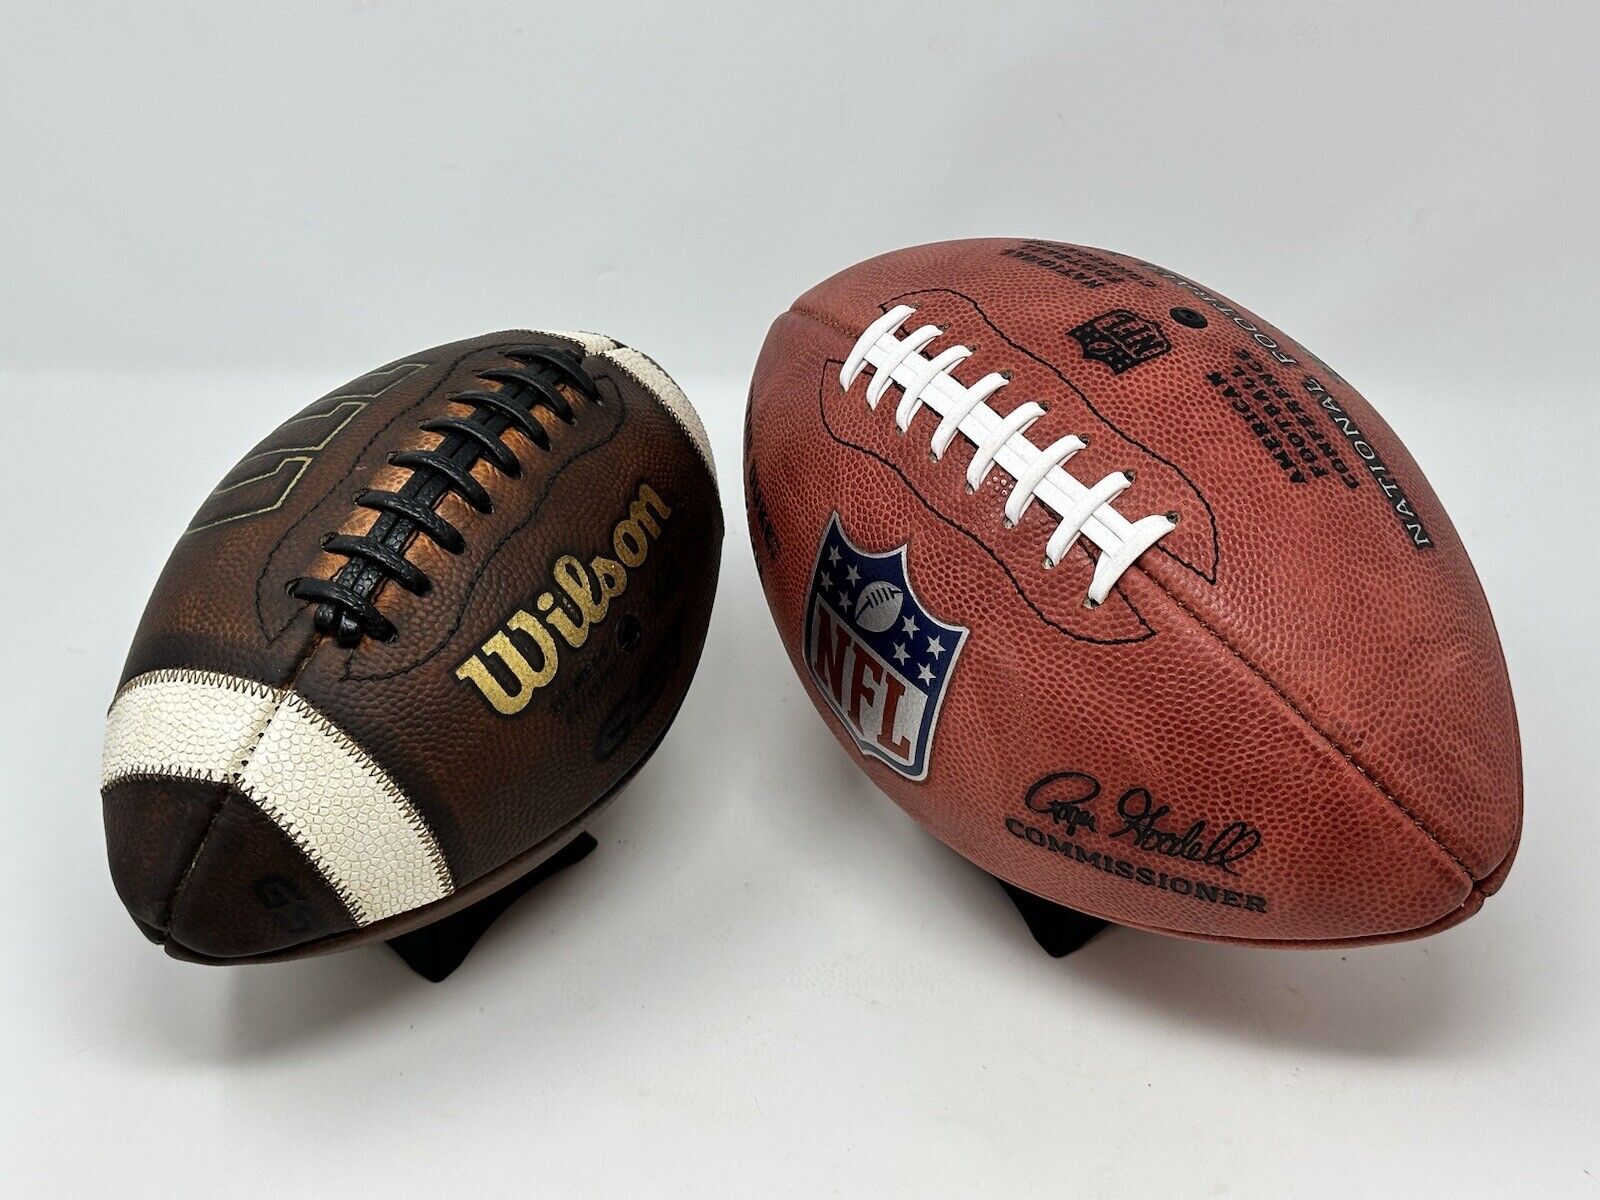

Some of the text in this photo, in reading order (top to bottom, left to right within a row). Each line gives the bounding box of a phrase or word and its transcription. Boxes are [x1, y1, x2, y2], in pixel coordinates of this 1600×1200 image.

[1205, 370, 1309, 484] AMERICAN
[1230, 364, 1329, 478] FOOTBALL
[1234, 349, 1360, 489] CONFERENCE
[1304, 376, 1431, 549] NATIONAL
[456, 483, 671, 714] Wilson
[813, 602, 912, 763] NFL
[1004, 816, 1268, 914] COMMISSIONER
